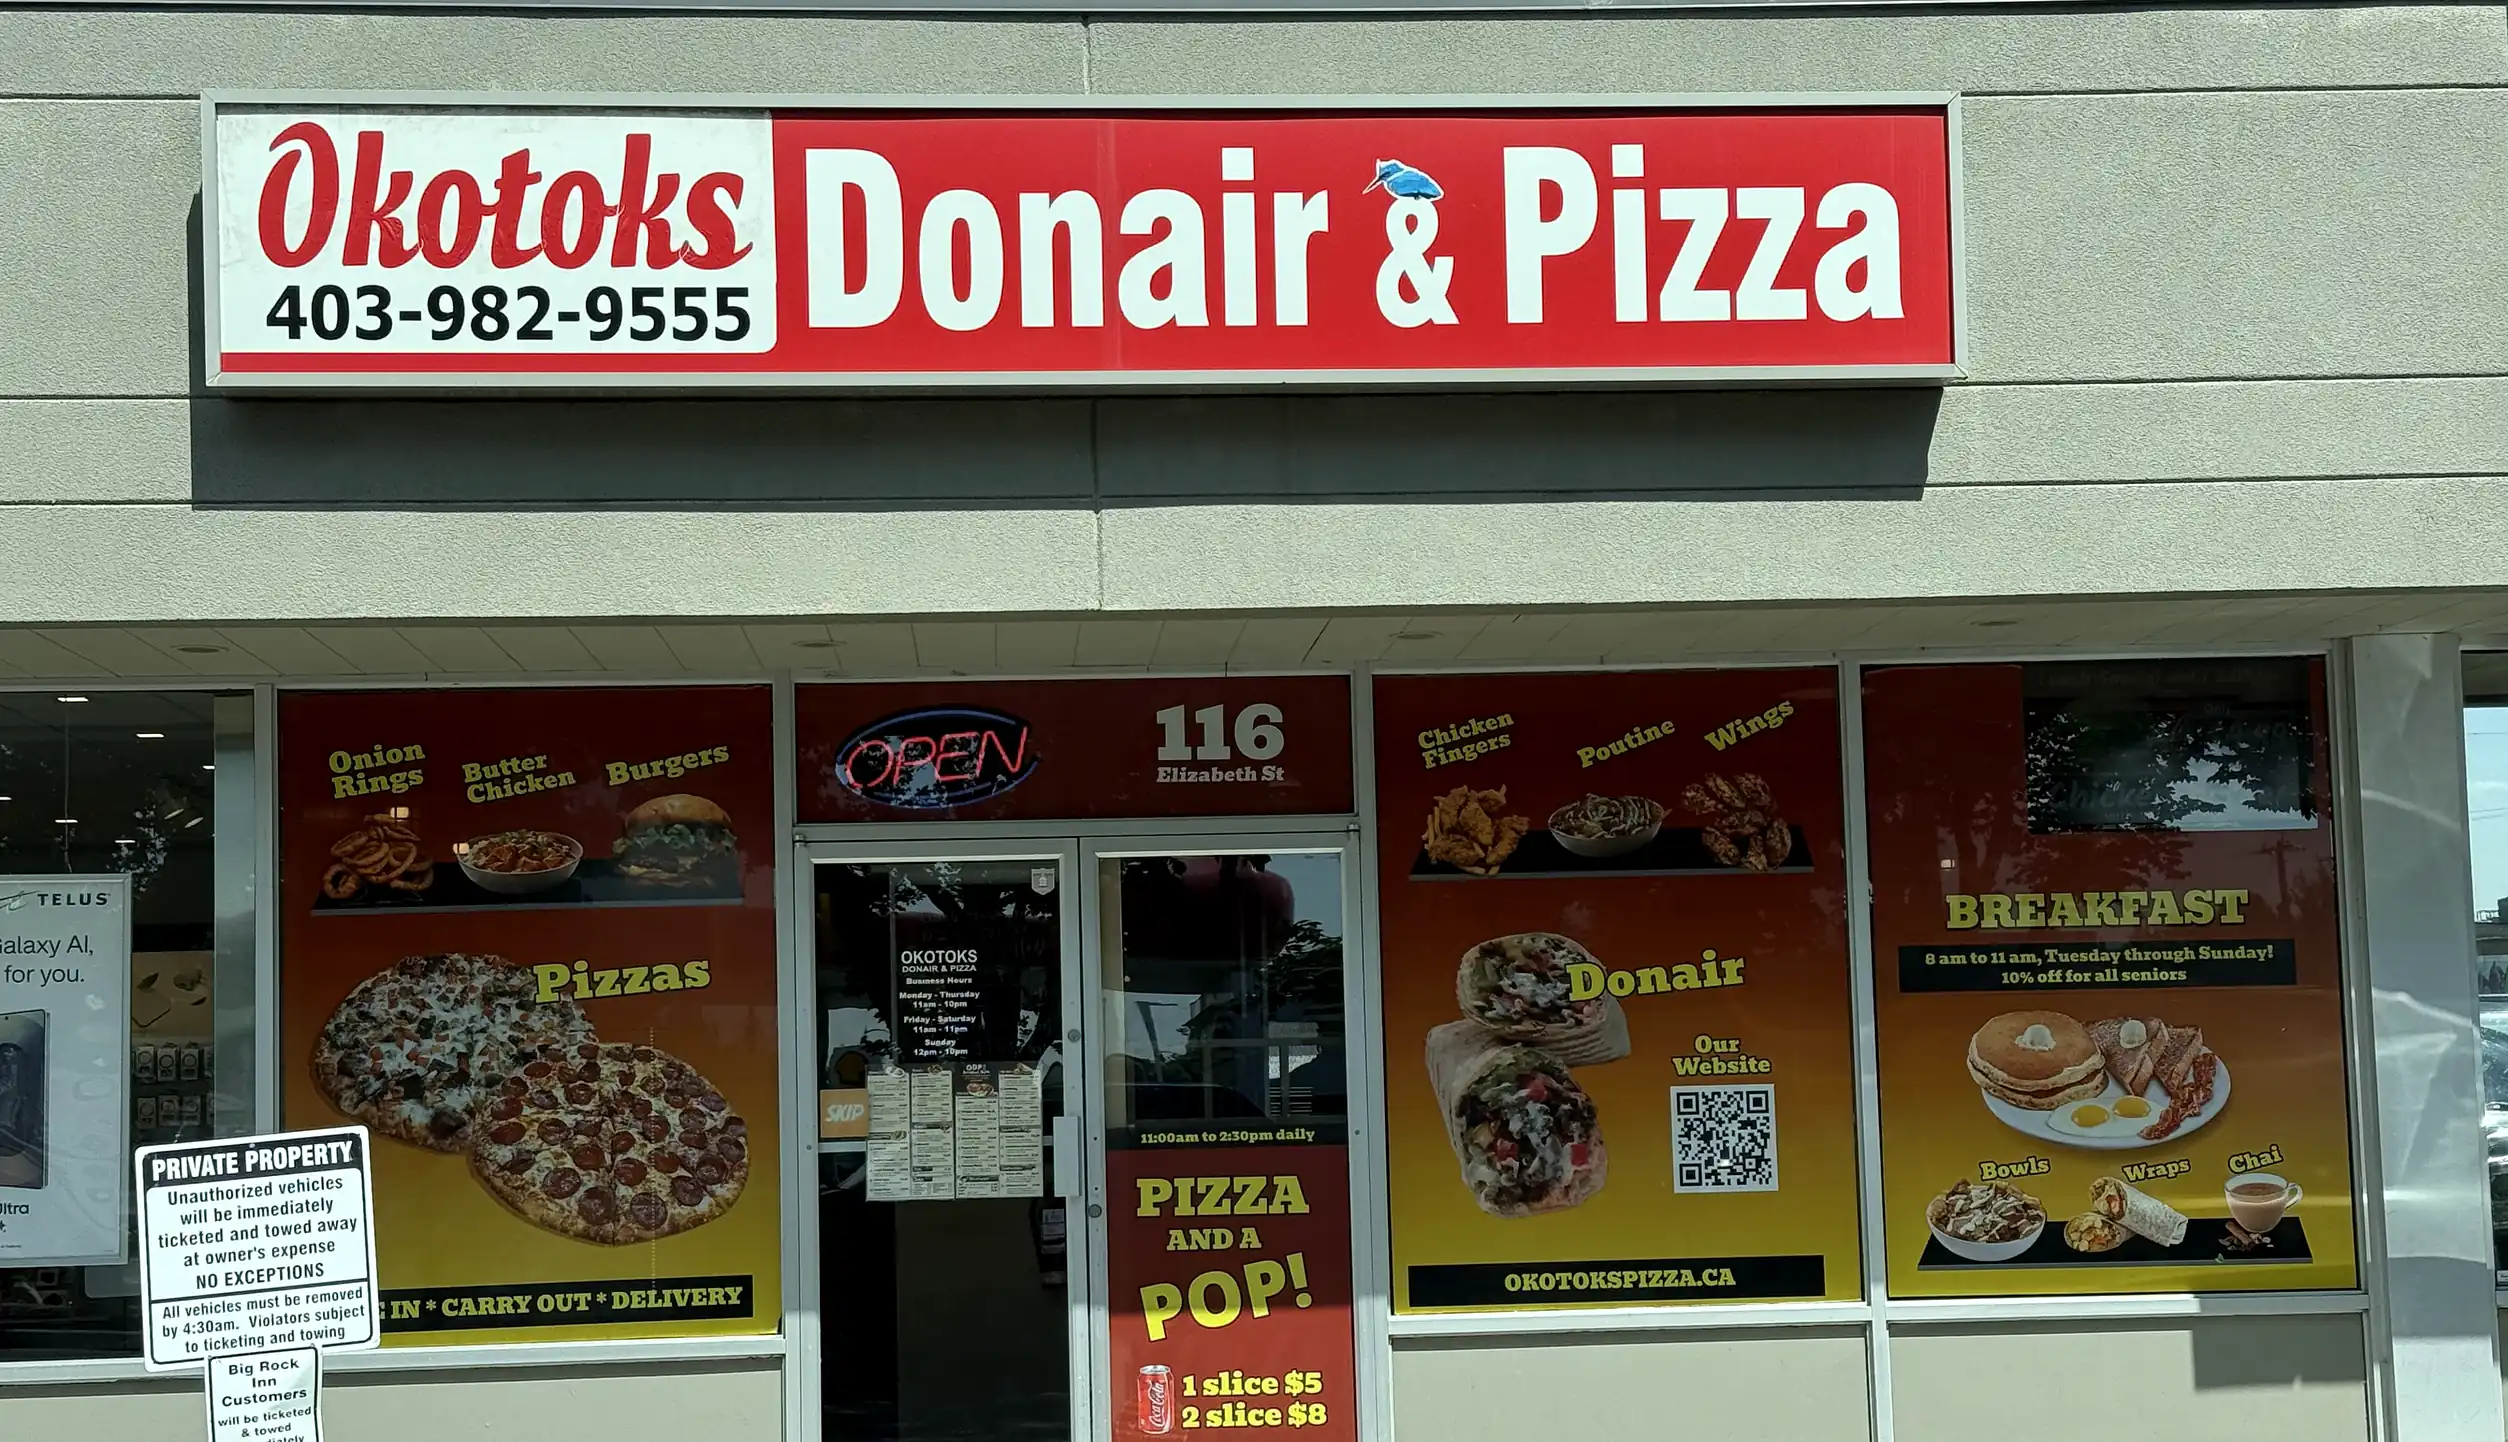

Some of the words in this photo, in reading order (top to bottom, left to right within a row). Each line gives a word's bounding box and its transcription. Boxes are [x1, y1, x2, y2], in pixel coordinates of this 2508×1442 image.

[256, 121, 753, 270] Okotoks
[805, 145, 1330, 332] Donair
[1375, 196, 1461, 328] &
[1503, 143, 1904, 325] Pizza
[265, 284, 751, 341] 403-982-9555
[1155, 703, 1284, 760] 116
[1417, 711, 1515, 751] Chicken
[1704, 700, 1795, 752] Wings
[844, 725, 1028, 788] OPEN
[1422, 732, 1512, 770] Fingers
[1577, 718, 1676, 769] Poutine
[329, 743, 426, 775] Onion
[462, 752, 548, 784] Butter
[605, 743, 730, 787] Burgers
[331, 767, 424, 800] Rings
[467, 768, 576, 805] Chicken
[1156, 766, 1258, 784] Elizabeth
[1260, 765, 1285, 782] St
[37, 892, 109, 907] TELUS
[1945, 889, 2249, 929] BREAKFAST
[0, 935, 61, 958] alaxy
[901, 949, 978, 964] OKOTOKS
[1925, 953, 1936, 965] 8
[1938, 954, 1968, 965] am
[1969, 951, 1988, 964] to
[1990, 950, 2007, 964] 11
[2008, 952, 2043, 966] am,
[2044, 947, 2121, 965] Tuesday
[2124, 946, 2196, 964] through
[2198, 944, 2275, 962] Sunday!
[4, 965, 35, 983] for
[40, 968, 85, 988] you.
[533, 959, 711, 1004] Pizzas
[902, 965, 939, 973] DONAIR
[941, 965, 947, 973] &
[950, 964, 977, 973] PIZZA
[906, 977, 944, 985] Business
[947, 977, 973, 985] Hours
[1565, 949, 1745, 1003] Donair
[2001, 970, 2034, 984] 10%
[2037, 969, 2063, 983] off
[2065, 968, 2092, 983] for
[2094, 968, 2119, 982] all
[2121, 968, 2187, 981] seniors
[899, 991, 932, 1000] Monday
[939, 991, 980, 999] Thursday
[944, 1000, 968, 1009] 10pm
[903, 1016, 931, 1024] Friday
[937, 1015, 976, 1023] Saturday
[944, 1025, 968, 1034] 11pm
[913, 1048, 937, 1057] 12pm
[944, 1048, 968, 1057] 10pm
[924, 1038, 956, 1047] Sunday
[1694, 1035, 1741, 1054] Our
[1672, 1055, 1772, 1077] Website
[826, 1104, 864, 1121] SKIP
[1141, 1132, 1199, 1144] 11:00am
[1202, 1131, 1217, 1143] to
[1219, 1129, 1274, 1143] 2:30pm
[1276, 1128, 1315, 1143] daily
[152, 1151, 239, 1181] PRIVATE
[245, 1140, 353, 1173] PROPERTY
[1980, 1156, 2051, 1182] Bowls
[2123, 1158, 2191, 1182] Wraps
[2228, 1145, 2283, 1174] Chai
[167, 1182, 273, 1205] Unauthorized
[279, 1176, 343, 1195] vehicles
[1136, 1175, 1310, 1217] PIZZA
[0, 1202, 29, 1215] ltra
[180, 1209, 208, 1225] will
[214, 1207, 233, 1222] be
[237, 1198, 333, 1220] immediately
[158, 1229, 223, 1248] ticketed
[230, 1226, 259, 1242] and
[265, 1219, 312, 1238] towed
[317, 1218, 357, 1234] away
[1167, 1228, 1234, 1251] AND
[1239, 1227, 1262, 1249] A
[183, 1253, 199, 1267] at
[205, 1246, 266, 1265] owner's
[271, 1240, 336, 1260] expense
[196, 1274, 217, 1290] NO
[225, 1262, 325, 1287] EXCEPTIONS
[1504, 1268, 1736, 1292] OKOTOKSPIZZA.CA
[162, 1305, 180, 1320] All
[185, 1297, 242, 1317] vehicles
[247, 1297, 280, 1311] must
[284, 1292, 301, 1306] be
[305, 1286, 363, 1304] removed
[391, 1300, 420, 1320] IN
[441, 1294, 532, 1317] CARRY
[537, 1291, 592, 1312] OUT
[611, 1286, 744, 1310] DELIVERY
[1139, 1252, 1312, 1342] POP!
[162, 1324, 177, 1338] by
[183, 1320, 240, 1336] 4:30am.
[248, 1310, 310, 1329] Violators
[315, 1304, 365, 1323] subject
[185, 1340, 198, 1353] to
[204, 1332, 265, 1351] ticketing
[270, 1329, 295, 1343] and
[300, 1325, 345, 1342] towing
[228, 1363, 254, 1376] Big
[259, 1358, 300, 1372] Rock
[252, 1377, 277, 1388] Inn
[1182, 1374, 1197, 1397] 1
[1202, 1370, 1279, 1396] slice
[1284, 1370, 1322, 1396] $5
[222, 1389, 307, 1407] Customers
[218, 1416, 239, 1427] will
[244, 1415, 259, 1424] be
[263, 1406, 312, 1421] ticketed
[1182, 1406, 1199, 1428] 2
[1206, 1401, 1282, 1427] slice
[1288, 1401, 1327, 1428] $8
[241, 1428, 250, 1438] &
[255, 1422, 291, 1436] towed
